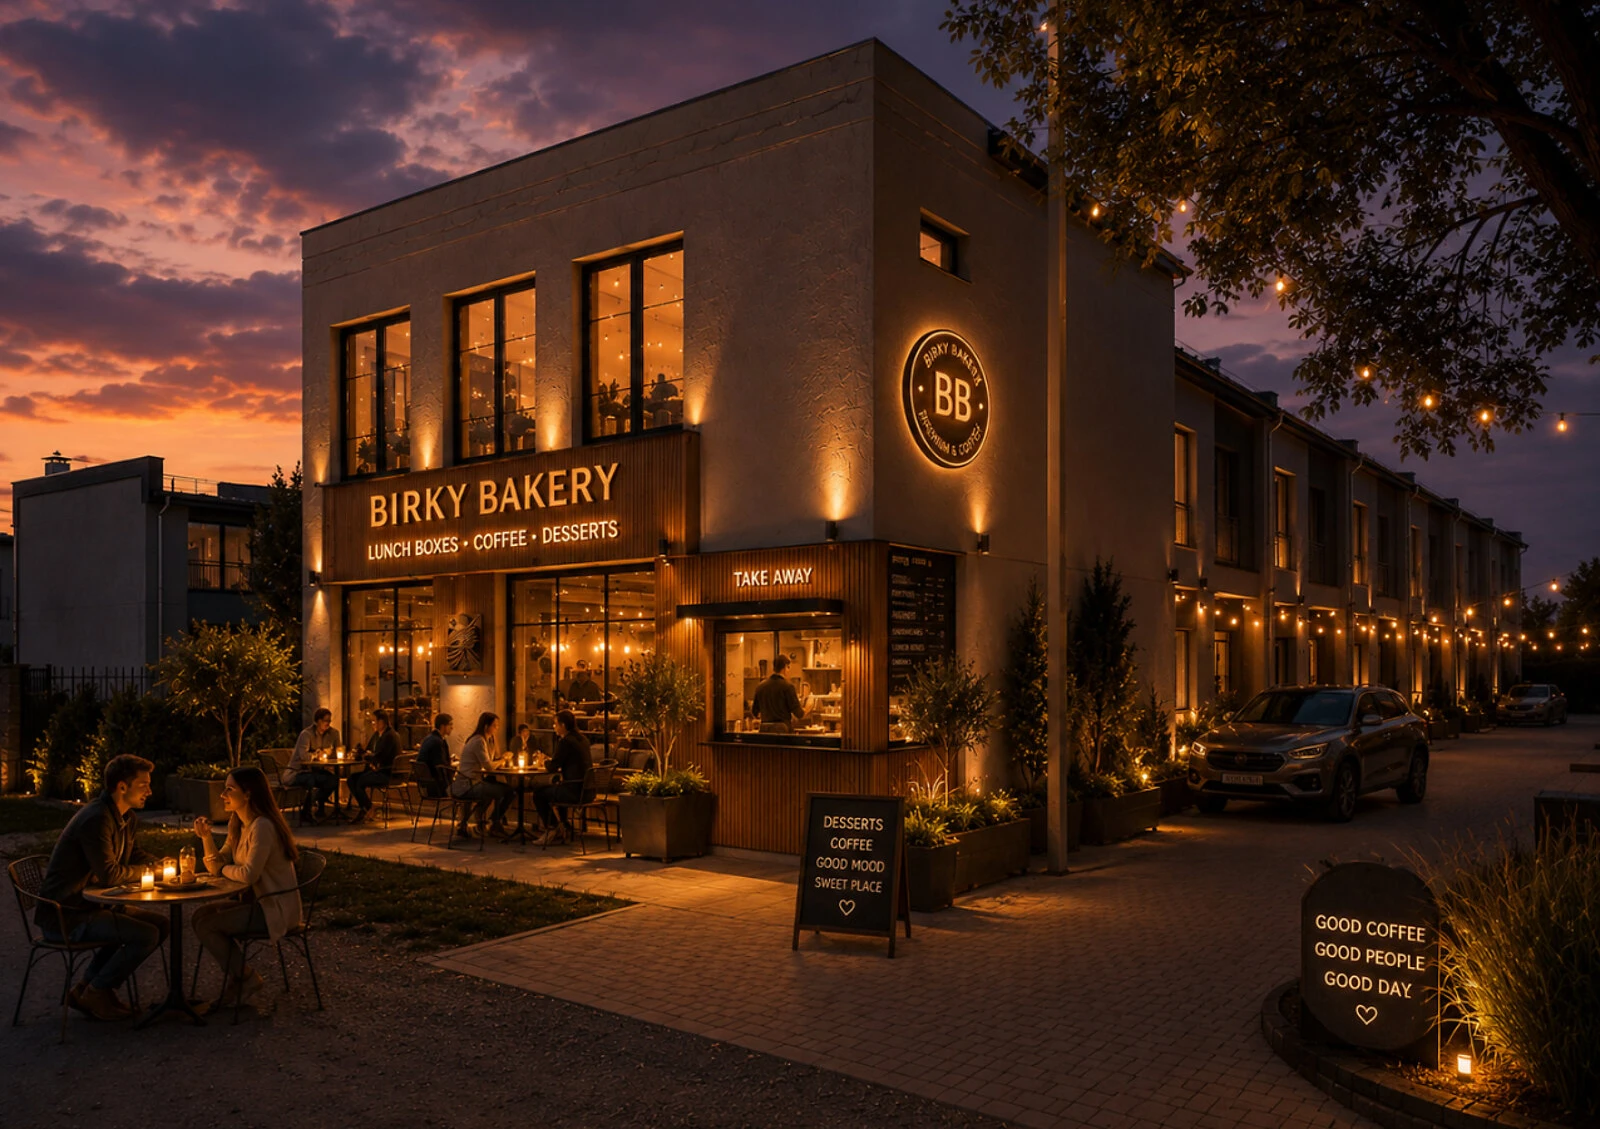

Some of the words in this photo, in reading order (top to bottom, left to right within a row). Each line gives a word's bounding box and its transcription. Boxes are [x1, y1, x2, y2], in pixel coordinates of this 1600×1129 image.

[923, 342, 949, 369] BIRKY
[935, 371, 972, 423] BB
[370, 483, 467, 528] BIRKY
[480, 462, 619, 516] BAKERY
[368, 541, 411, 561] LUNCH
[415, 536, 459, 554] BOXES
[473, 529, 527, 551] COFFEE
[542, 520, 618, 544] DESSERTS
[734, 570, 768, 587] TAKE
[773, 567, 813, 585] AWAY
[823, 815, 884, 832] DESSERTS
[830, 837, 873, 852] COFFEE
[815, 856, 848, 870] GOOD
[851, 859, 885, 873] MOOD
[814, 876, 849, 890] SWEET
[850, 879, 883, 893] PLACE
[1315, 914, 1362, 934] GOOD
[1366, 921, 1426, 943] COFFEE
[1314, 941, 1361, 962] GOOD
[1366, 948, 1426, 972] PEOPLE
[1324, 970, 1373, 992] GOOD
[1378, 979, 1412, 999] DAY
